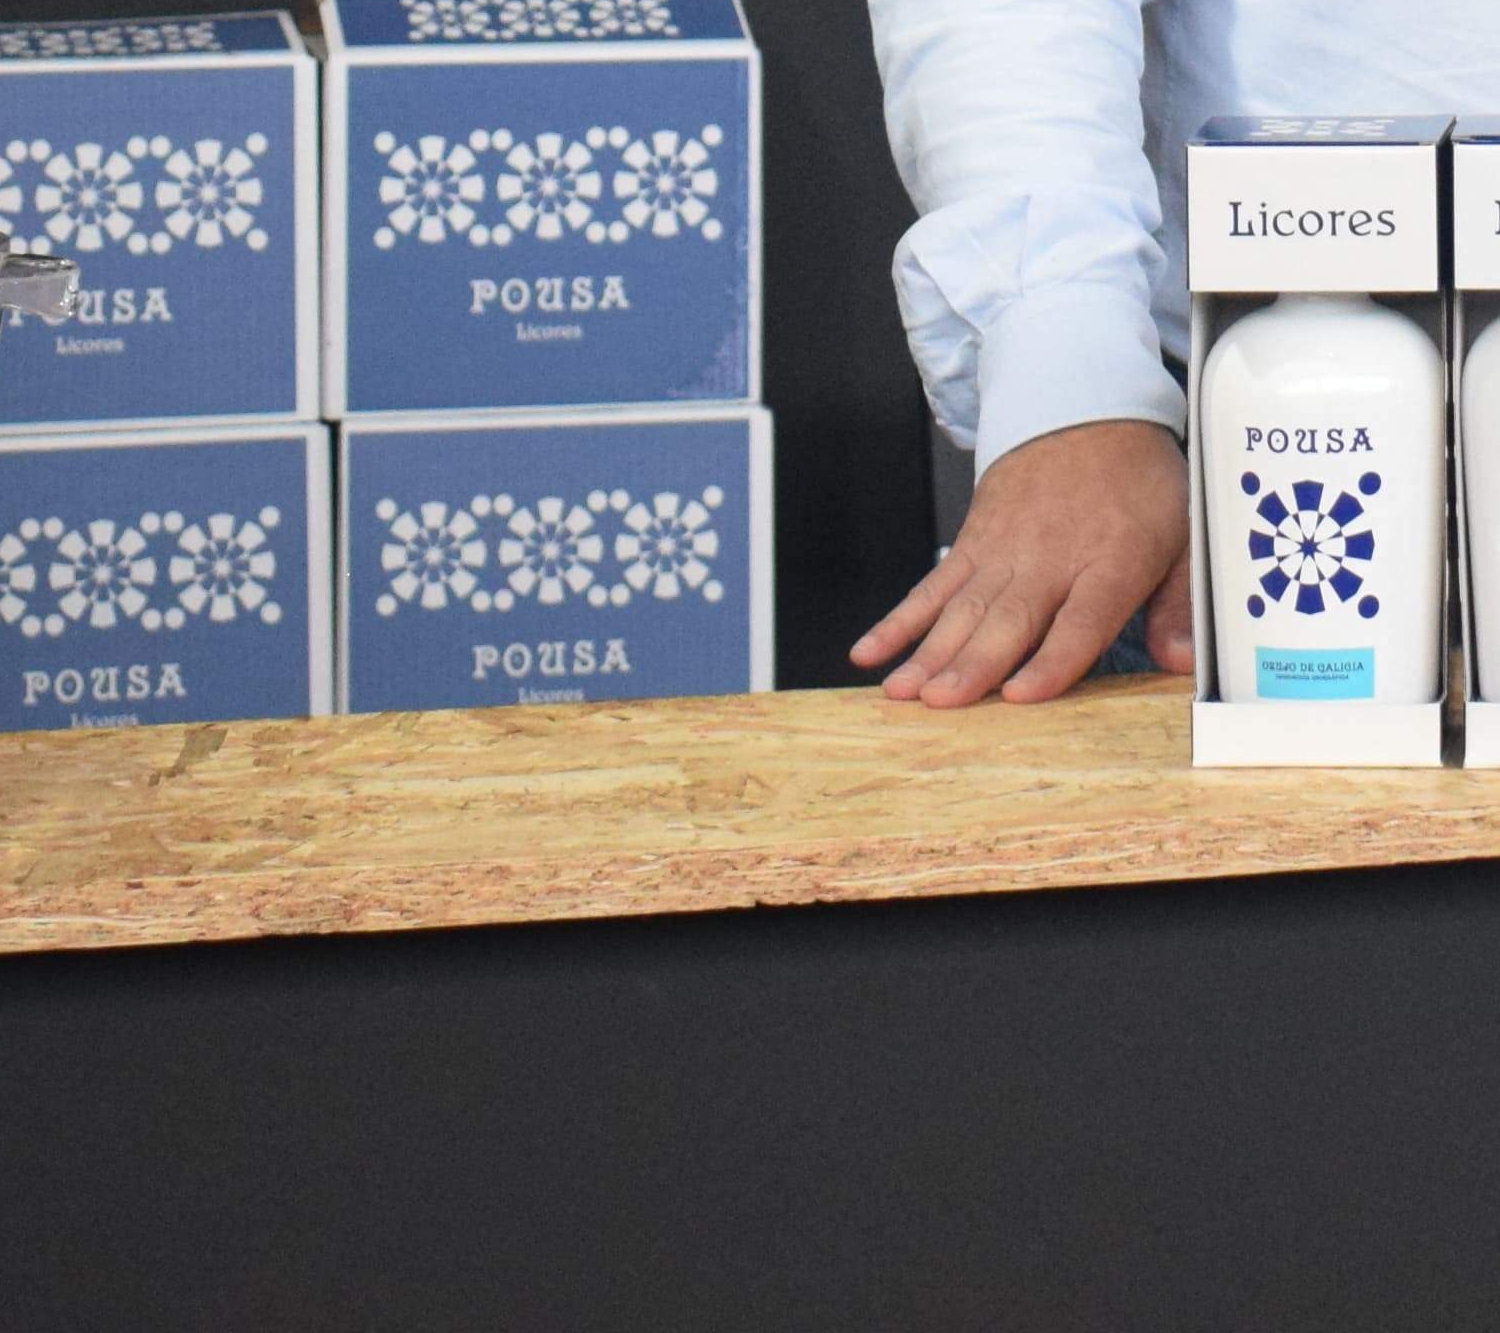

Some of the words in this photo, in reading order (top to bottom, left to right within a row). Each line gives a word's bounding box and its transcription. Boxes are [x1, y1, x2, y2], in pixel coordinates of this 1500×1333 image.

[1229, 201, 1396, 238] Licores
[469, 276, 630, 315] POUSA
[1245, 426, 1374, 454] POUSA
[472, 638, 631, 680] POUSA
[1300, 662, 1315, 672] DE
[1318, 661, 1364, 673] GALICIA
[22, 663, 187, 706] POUSA
